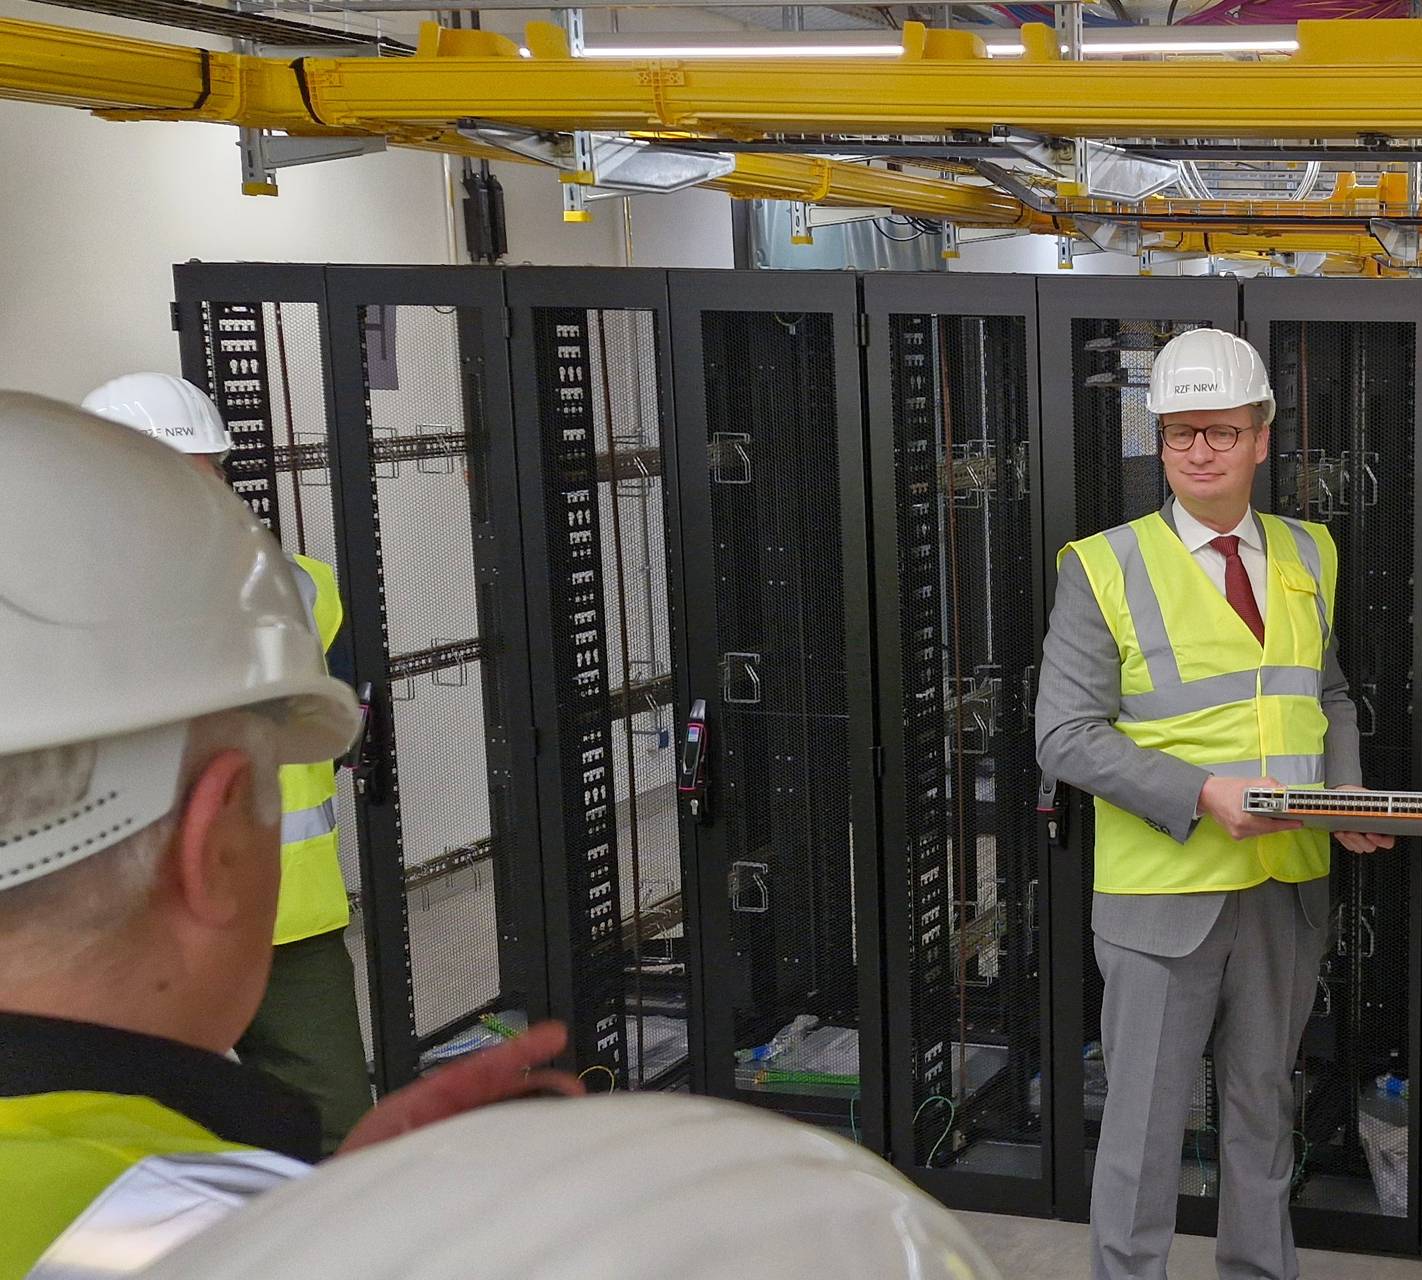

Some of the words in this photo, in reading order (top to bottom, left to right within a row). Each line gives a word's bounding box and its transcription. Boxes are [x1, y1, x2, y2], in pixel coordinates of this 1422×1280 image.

[1174, 384, 1191, 394] RZF
[1193, 383, 1218, 392] NRW
[165, 427, 194, 437] NRW
